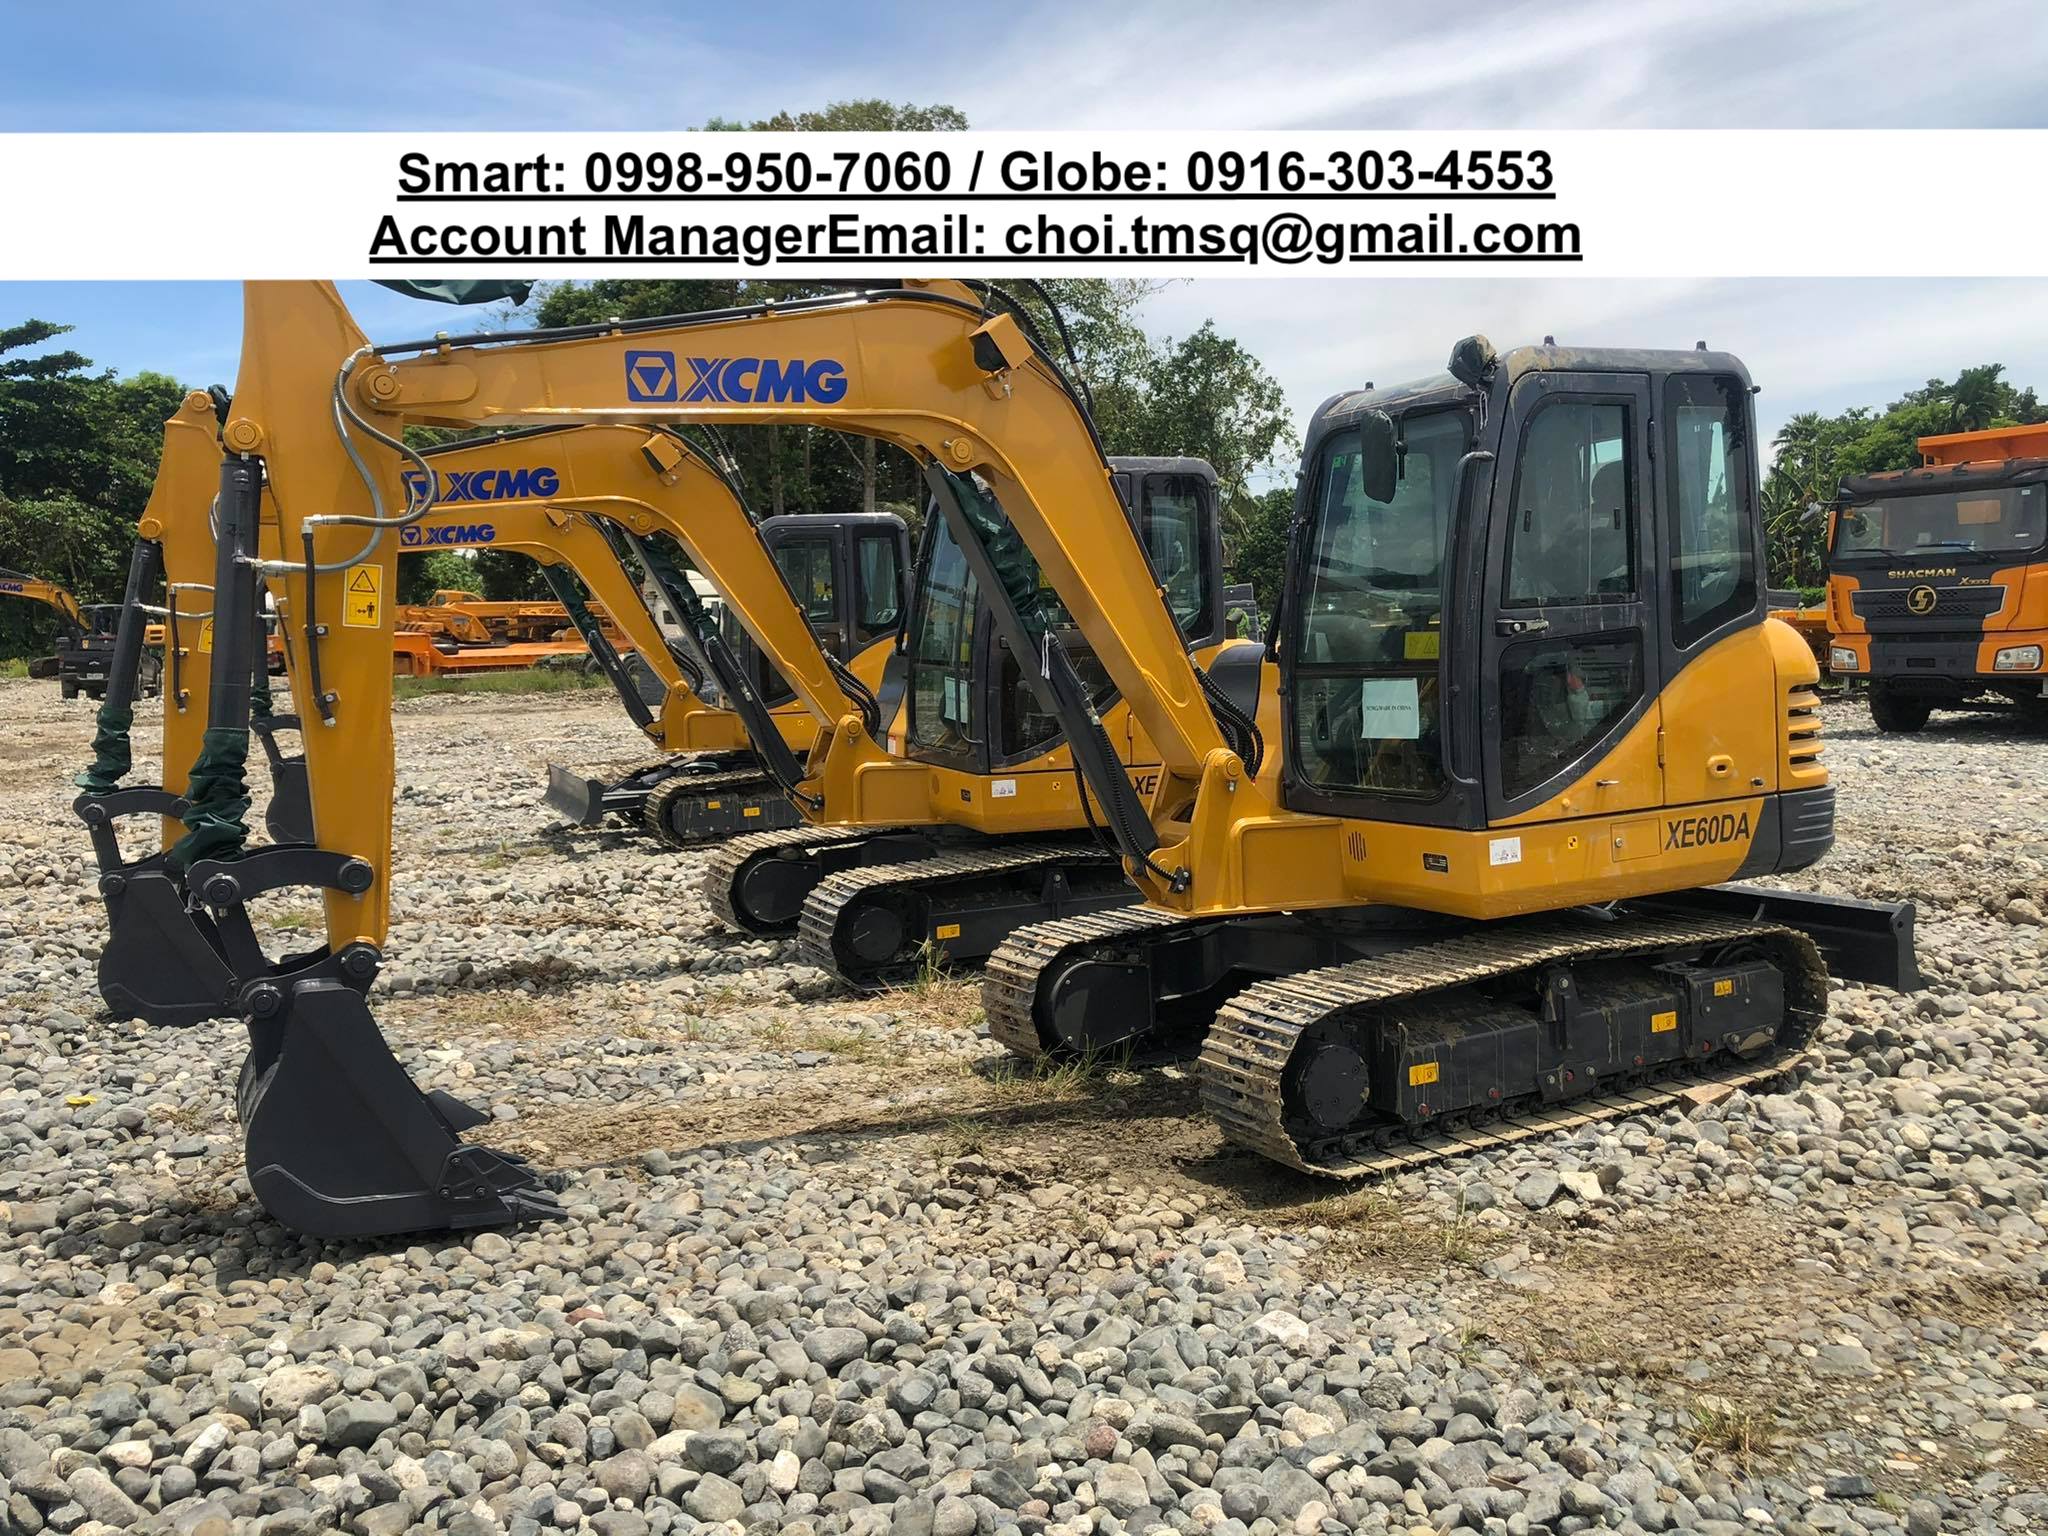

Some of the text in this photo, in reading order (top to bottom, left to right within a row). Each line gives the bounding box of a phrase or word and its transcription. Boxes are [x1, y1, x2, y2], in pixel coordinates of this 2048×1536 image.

[678, 357, 848, 404] XCMG
[443, 467, 560, 502] XCMG
[423, 524, 495, 545] XCMG
[1888, 568, 1956, 579] SHACMAN
[1664, 812, 1750, 851] XE60DA
